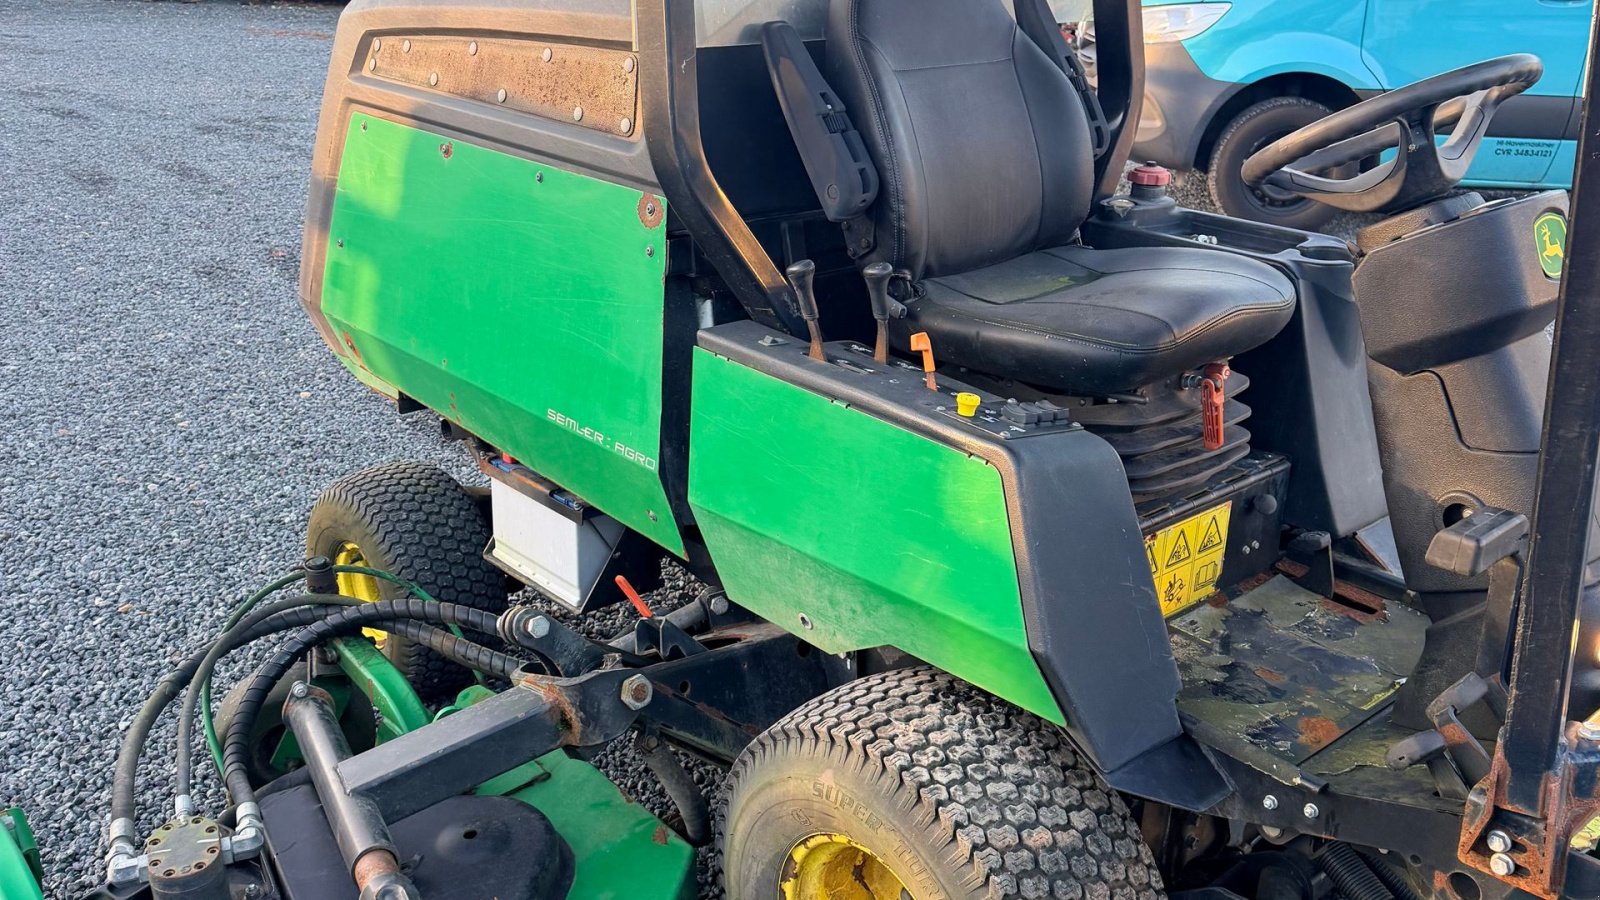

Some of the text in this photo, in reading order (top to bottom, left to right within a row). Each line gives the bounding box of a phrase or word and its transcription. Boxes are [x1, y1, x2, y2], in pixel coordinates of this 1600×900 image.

[547, 408, 604, 445] SEMLER
[614, 442, 656, 470] AGRO
[812, 781, 945, 900] SUPER TUR
